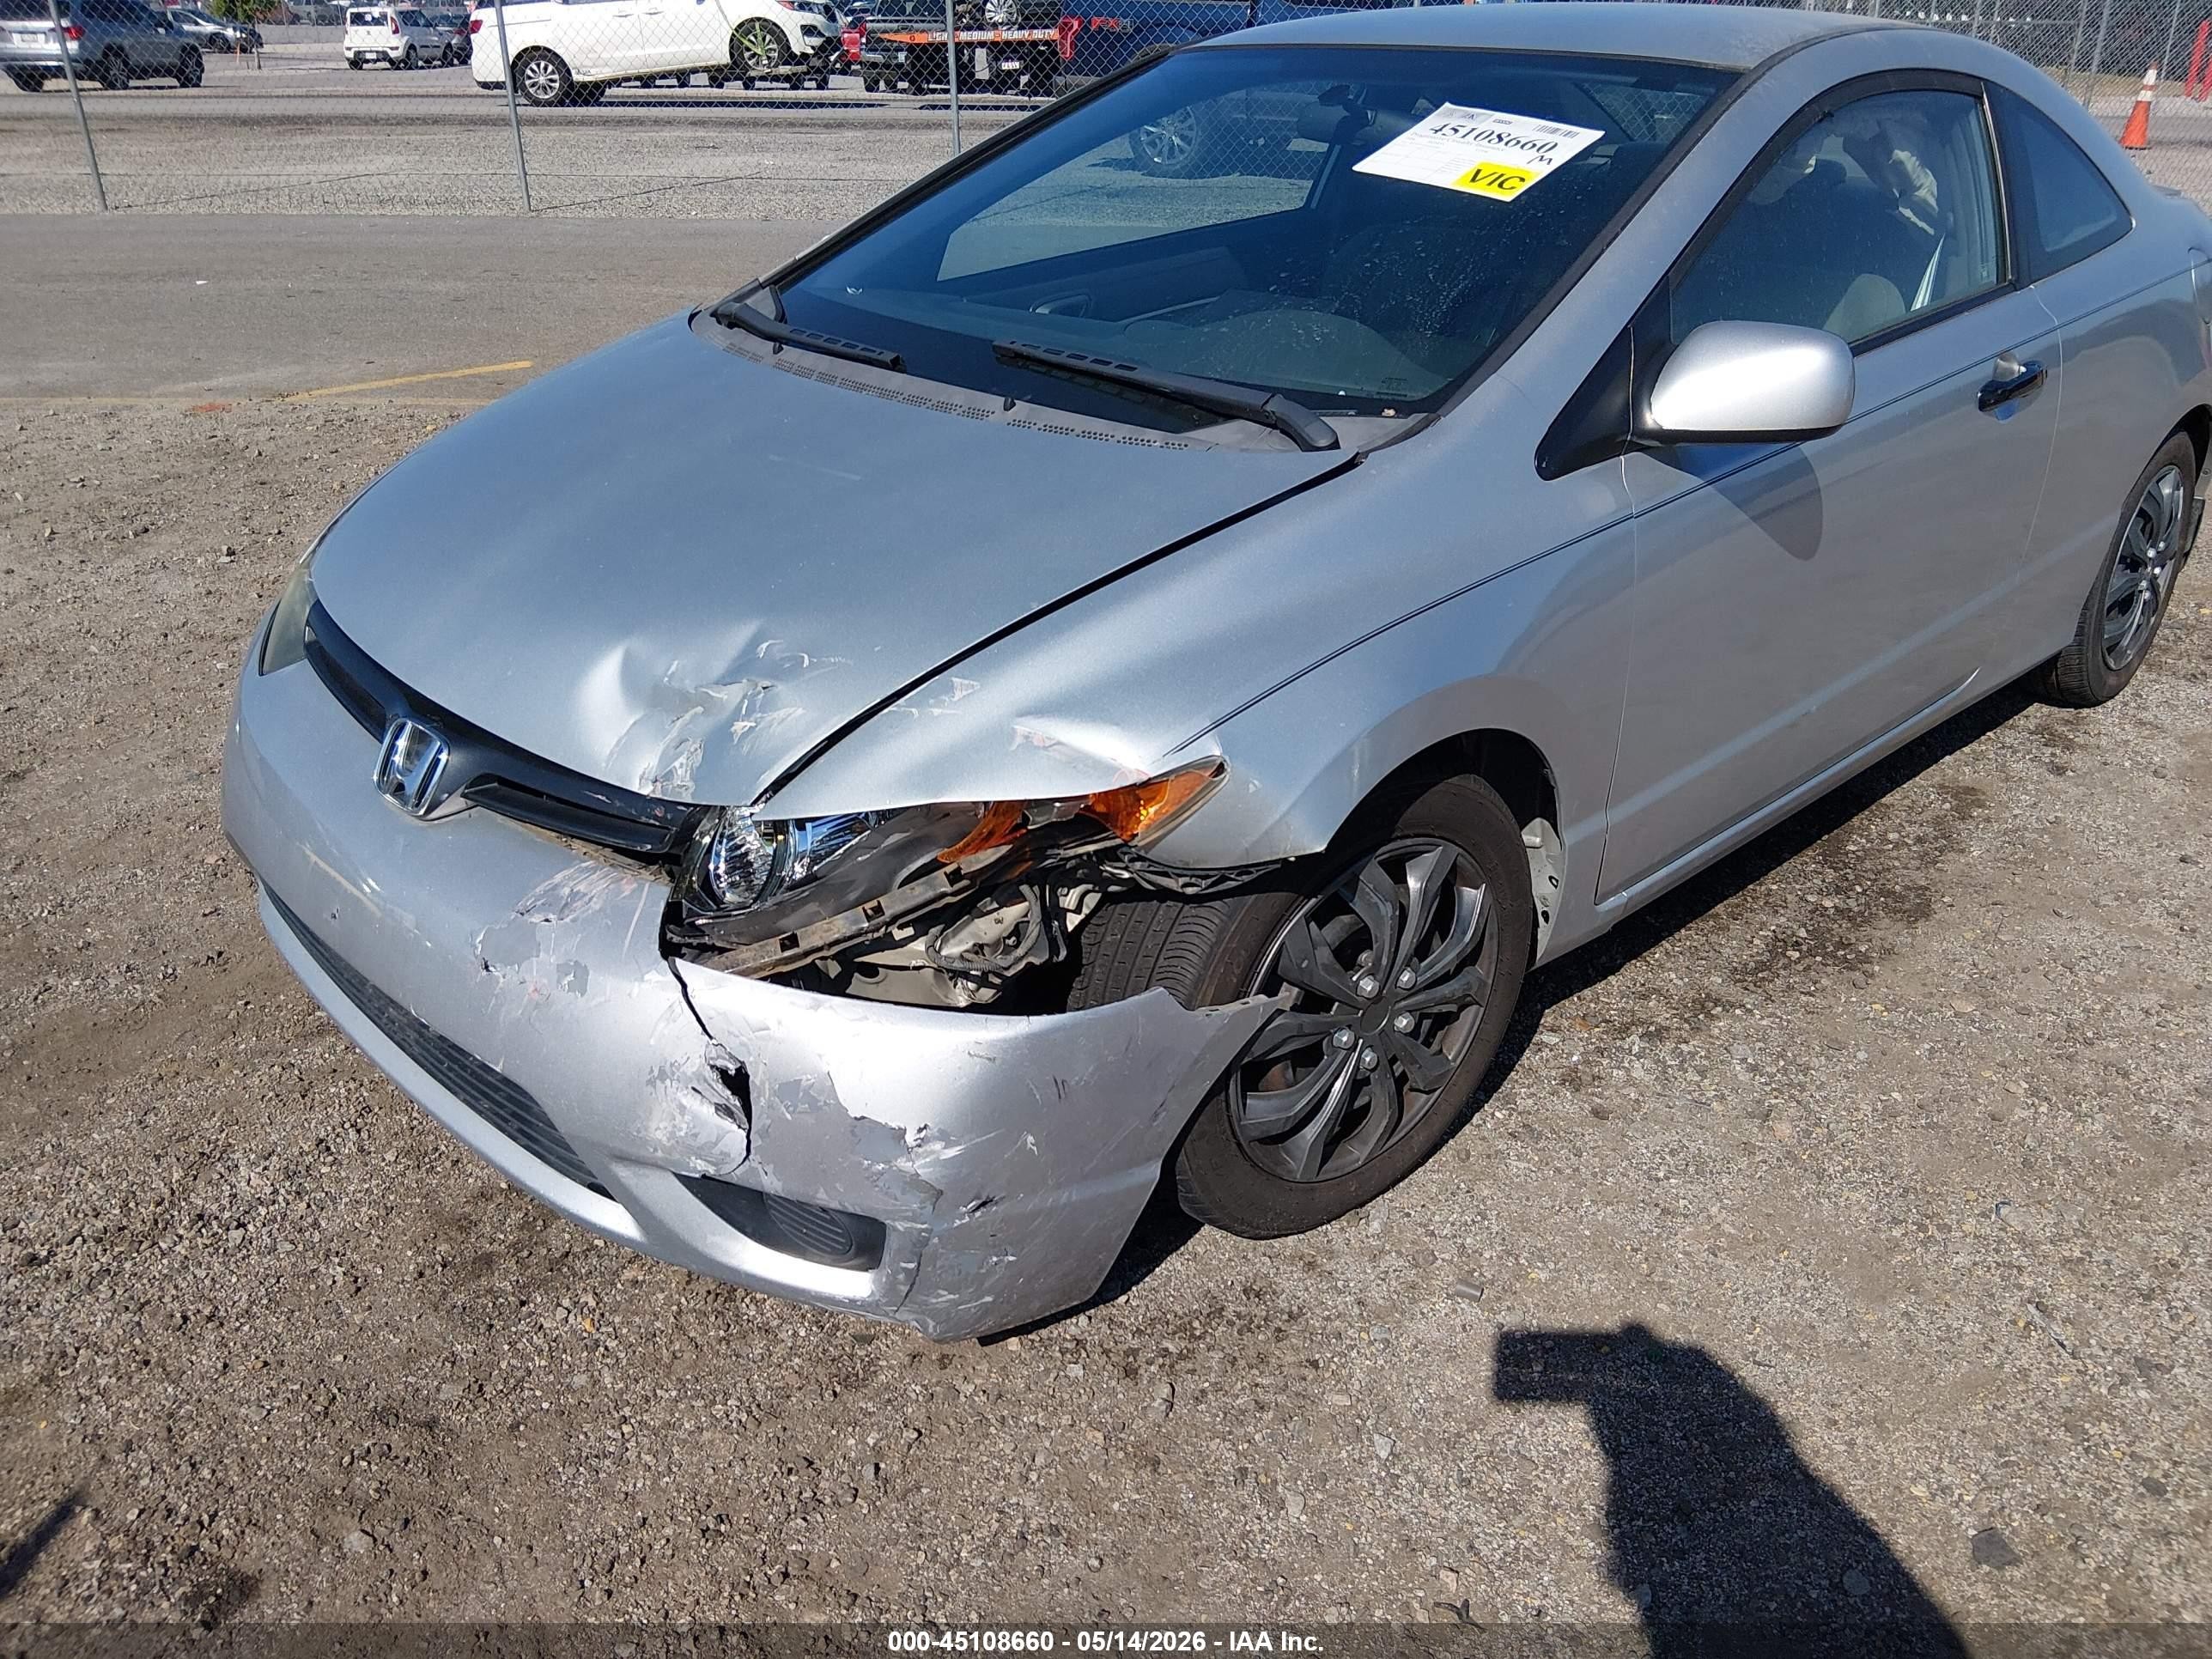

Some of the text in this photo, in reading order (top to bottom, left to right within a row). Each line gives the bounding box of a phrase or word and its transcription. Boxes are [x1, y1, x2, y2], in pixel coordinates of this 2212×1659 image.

[927, 30, 949, 41] LIGH
[959, 30, 994, 40] MEDIUM
[1001, 29, 1030, 40] HEAVY
[1032, 28, 1055, 39] DUTY
[1429, 122, 1559, 155] 45108660
[1469, 168, 1526, 191] VIC
